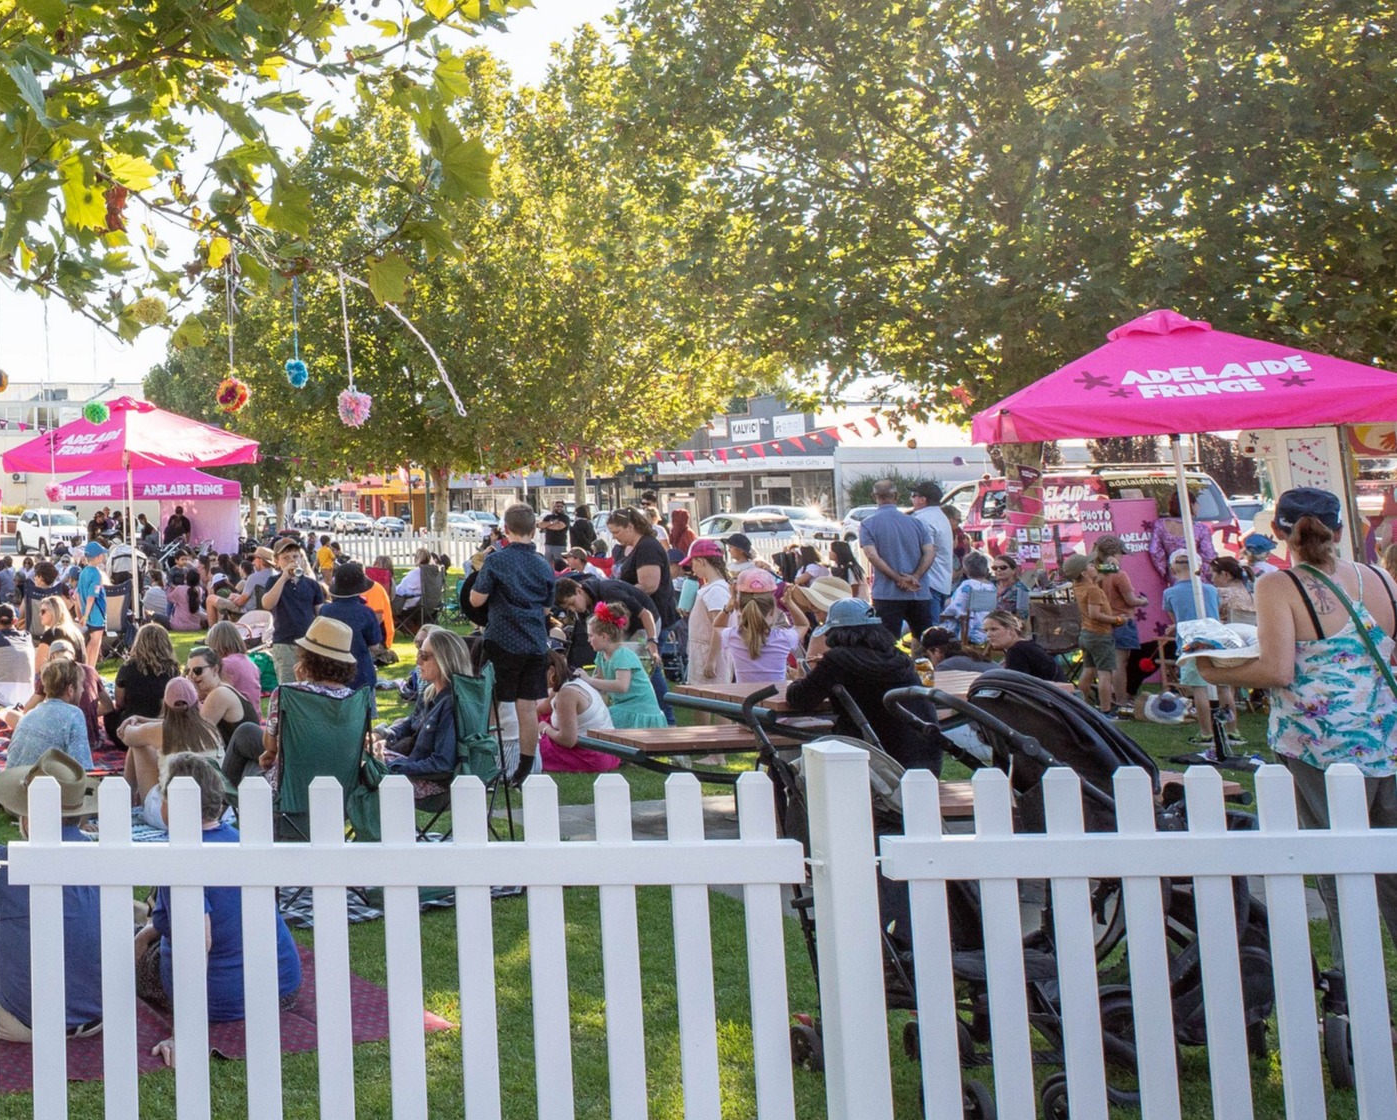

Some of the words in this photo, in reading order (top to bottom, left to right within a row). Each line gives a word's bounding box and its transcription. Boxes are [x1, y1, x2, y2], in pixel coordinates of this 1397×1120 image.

[1121, 355, 1312, 385] ADELAIDE
[1137, 378, 1266, 399] FRINGE
[61, 428, 123, 445] ADELAIDE
[55, 443, 99, 456] FRINGE
[143, 484, 191, 496] ADELAIDE
[193, 484, 224, 495] FRINGE
[1043, 485, 1091, 501] ELAIDE
[1080, 510, 1112, 520] PHOTO
[1081, 522, 1113, 531] BOOTH
[1119, 533, 1152, 542] ADELAI
